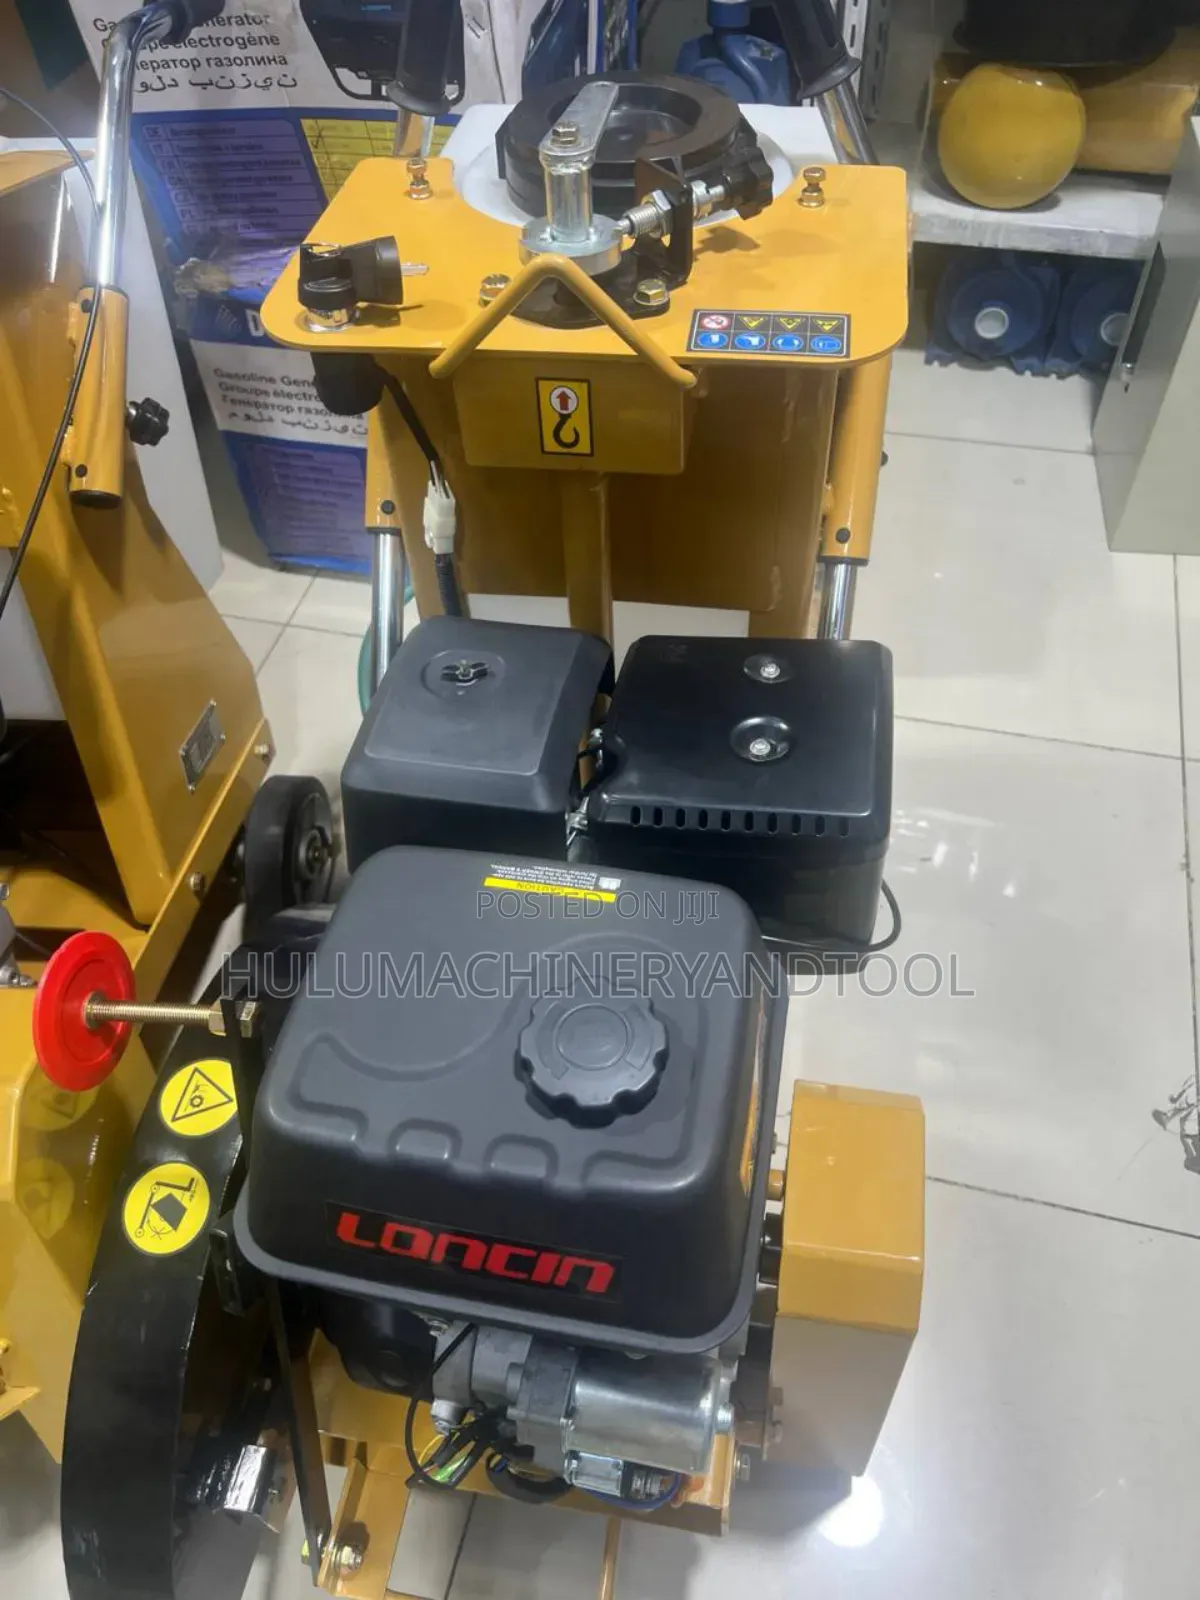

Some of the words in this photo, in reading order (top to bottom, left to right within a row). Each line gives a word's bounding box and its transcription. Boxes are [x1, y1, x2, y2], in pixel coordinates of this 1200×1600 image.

[206, 54, 288, 70] газолина
[213, 368, 277, 385] Gasoline
[218, 381, 271, 398] Groupe
